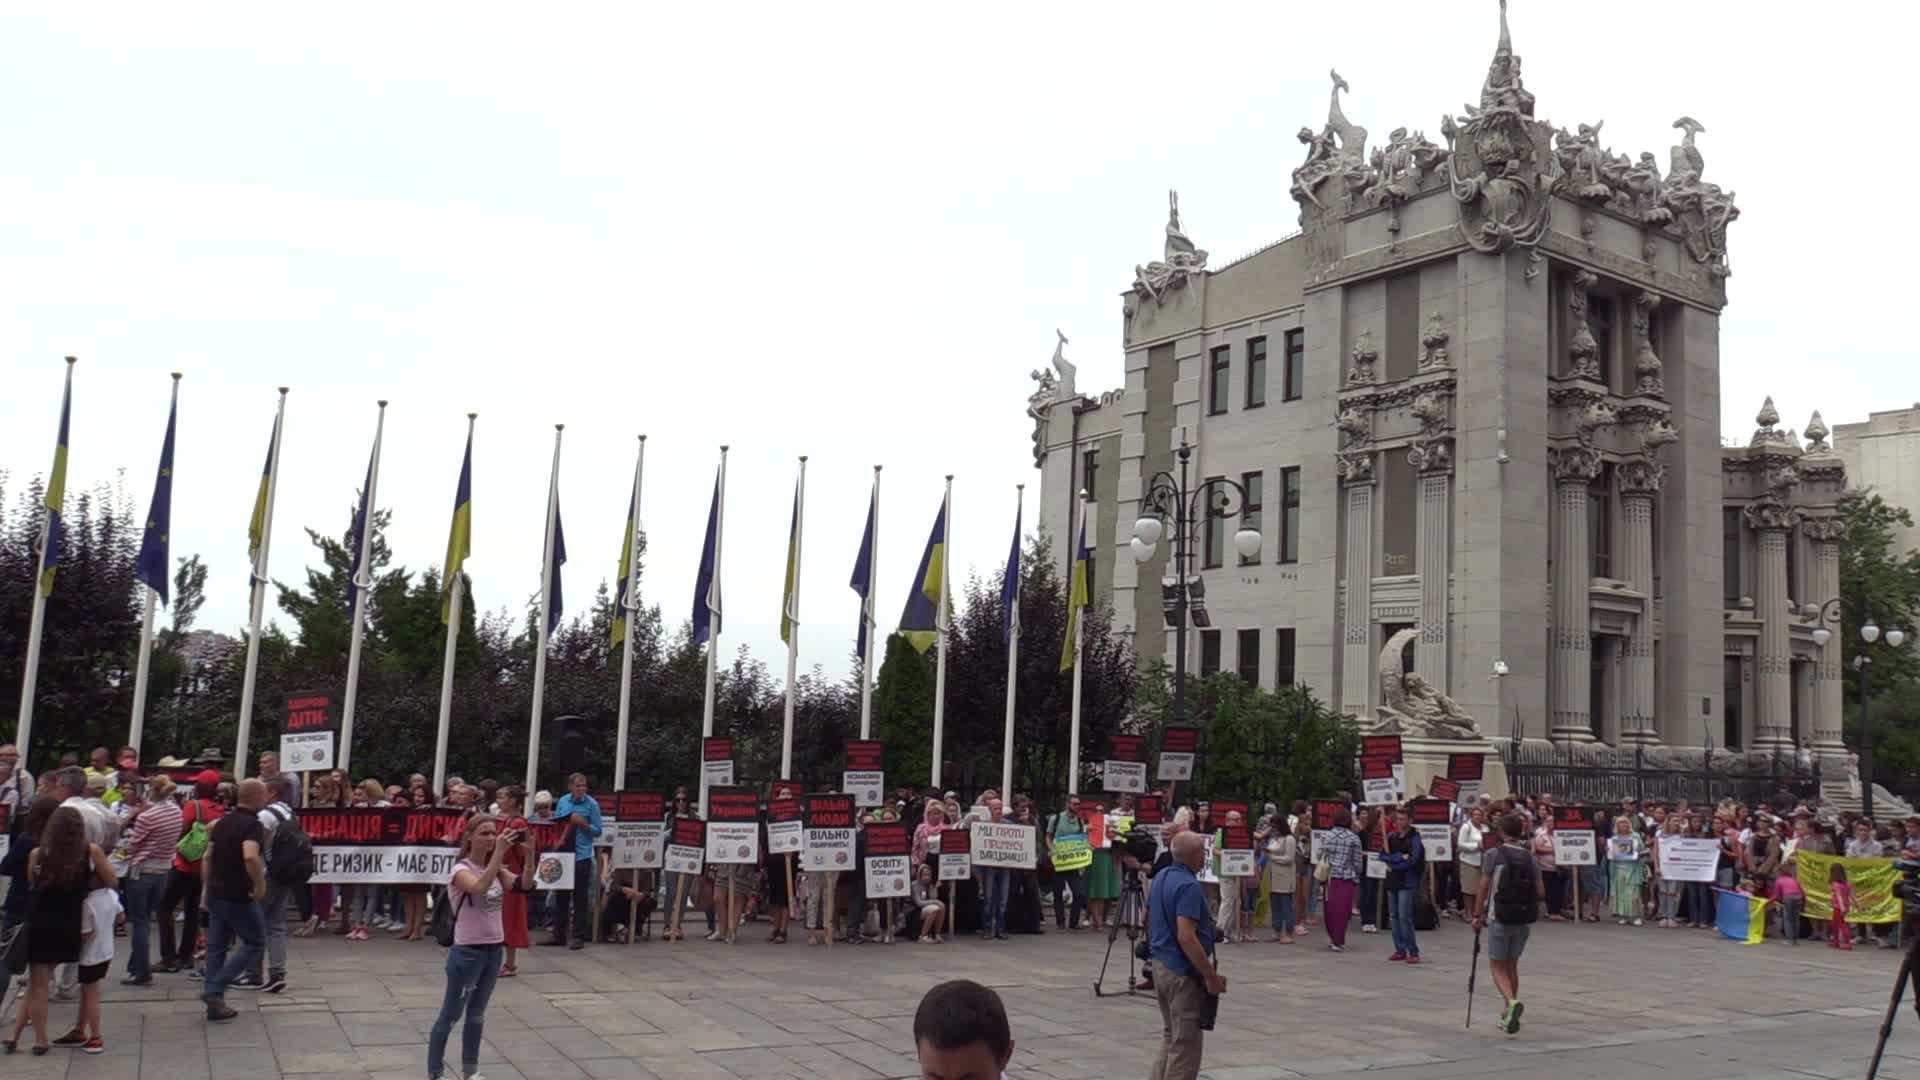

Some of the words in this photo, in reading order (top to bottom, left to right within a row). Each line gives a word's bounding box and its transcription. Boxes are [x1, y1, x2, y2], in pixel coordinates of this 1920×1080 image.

[810, 813, 848, 825] ЛЮДИ
[810, 830, 848, 841] ВІЛЬНО
[332, 854, 383, 873] РИЗИК
[396, 854, 427, 873] МАЄ
